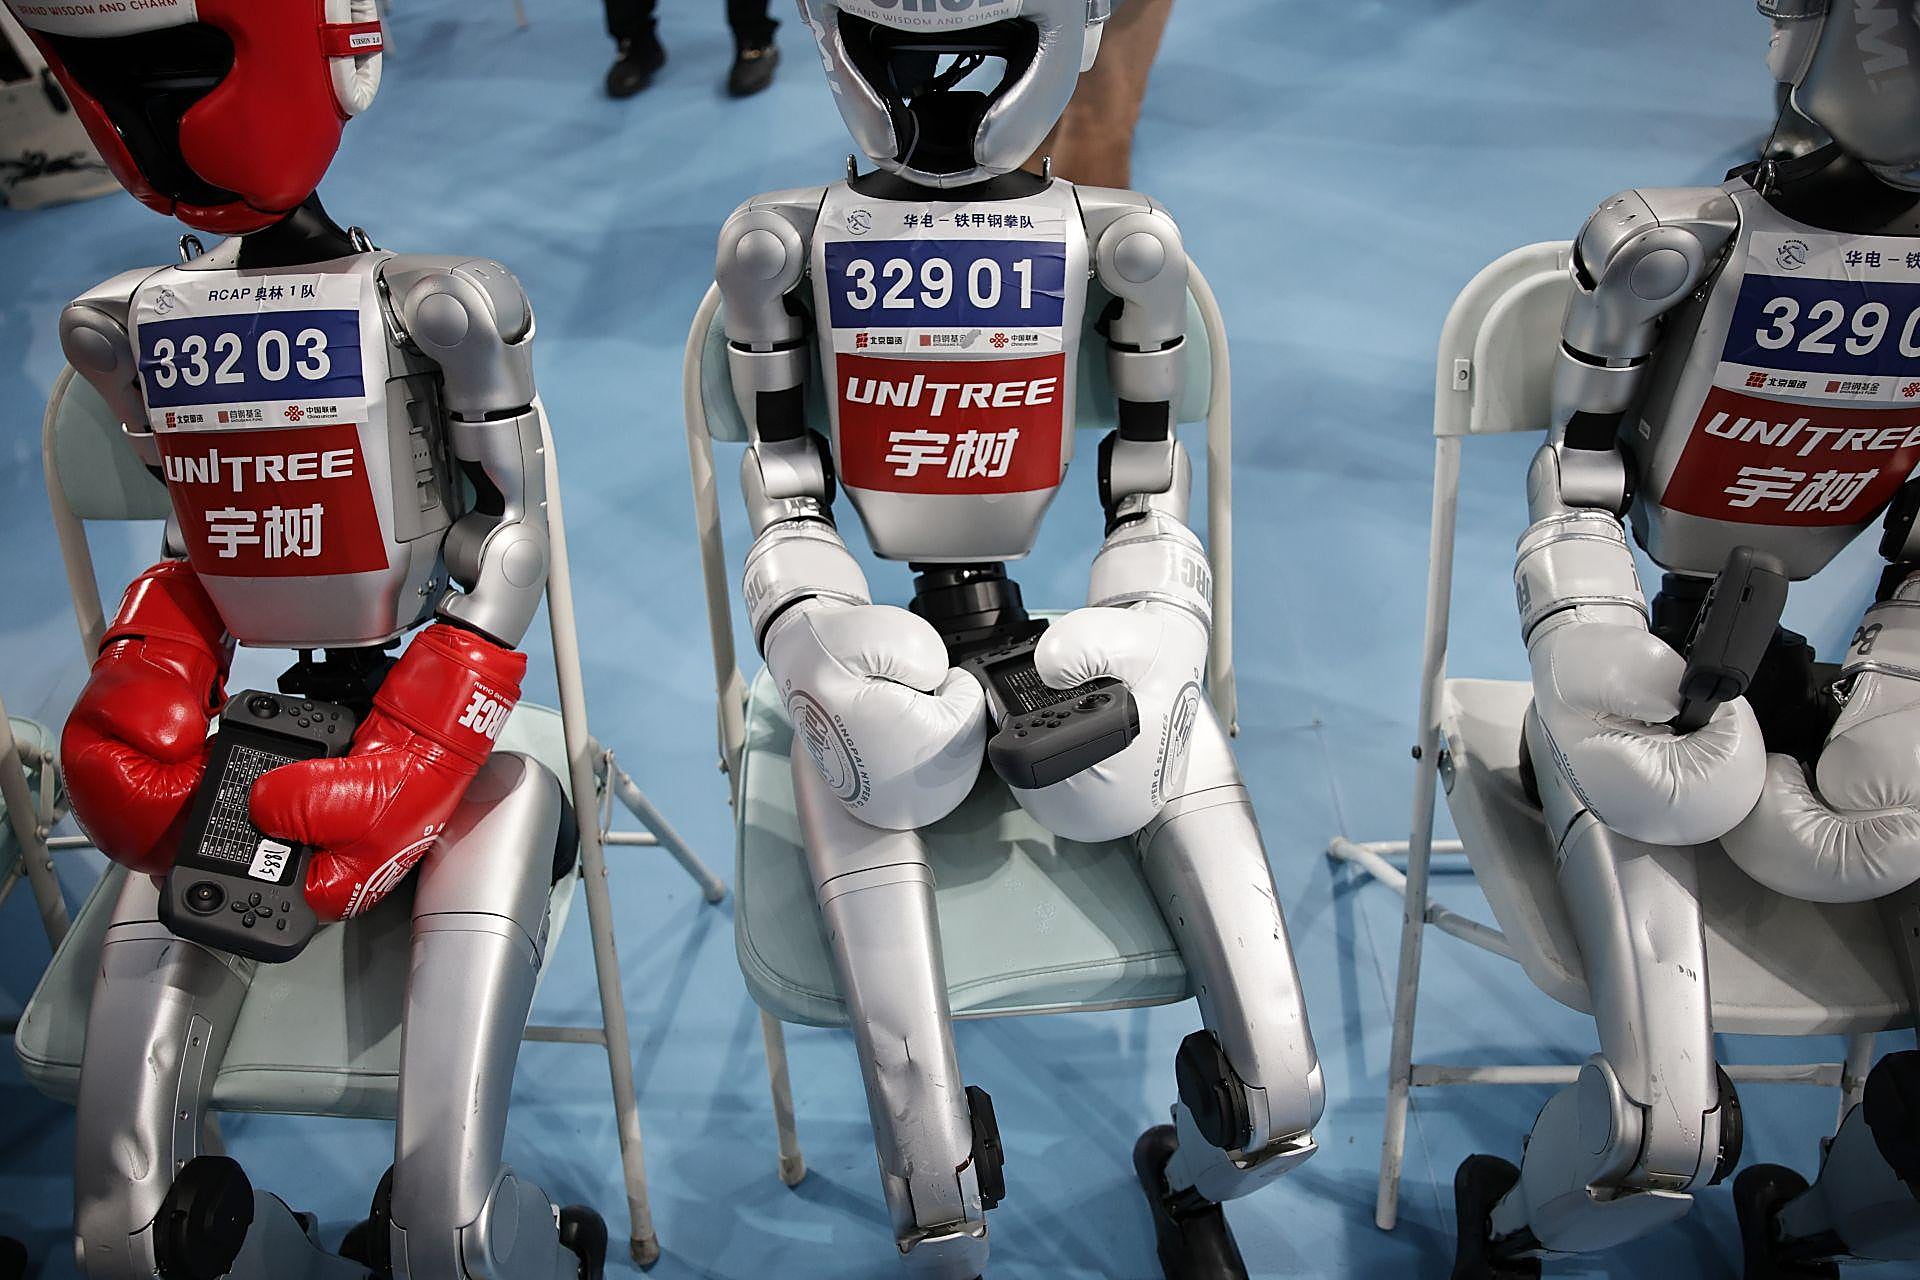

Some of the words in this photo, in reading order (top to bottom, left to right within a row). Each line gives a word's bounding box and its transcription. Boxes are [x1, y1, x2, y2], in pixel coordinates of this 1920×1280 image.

[49, 4, 96, 16] WISDOM
[99, 2, 127, 14] AND
[130, 0, 179, 11] CHARM
[882, 12, 933, 26] WISDOM
[937, 15, 964, 25] AND
[967, 7, 1011, 23] CHARM
[208, 287, 251, 302] RCAP
[845, 257, 954, 310] 329
[967, 258, 1032, 309] 01
[1755, 296, 1890, 356] 329
[153, 332, 245, 389] 332
[256, 328, 331, 382] 03
[845, 374, 1058, 417] UNITREE
[165, 448, 354, 492] UNITREE
[884, 427, 1020, 478] 宇树
[1723, 466, 1880, 512] 宇树
[205, 503, 324, 559] 宇树
[457, 690, 511, 742] RCE
[1156, 712, 1169, 764] SERIES
[860, 771, 872, 803] HYPER
